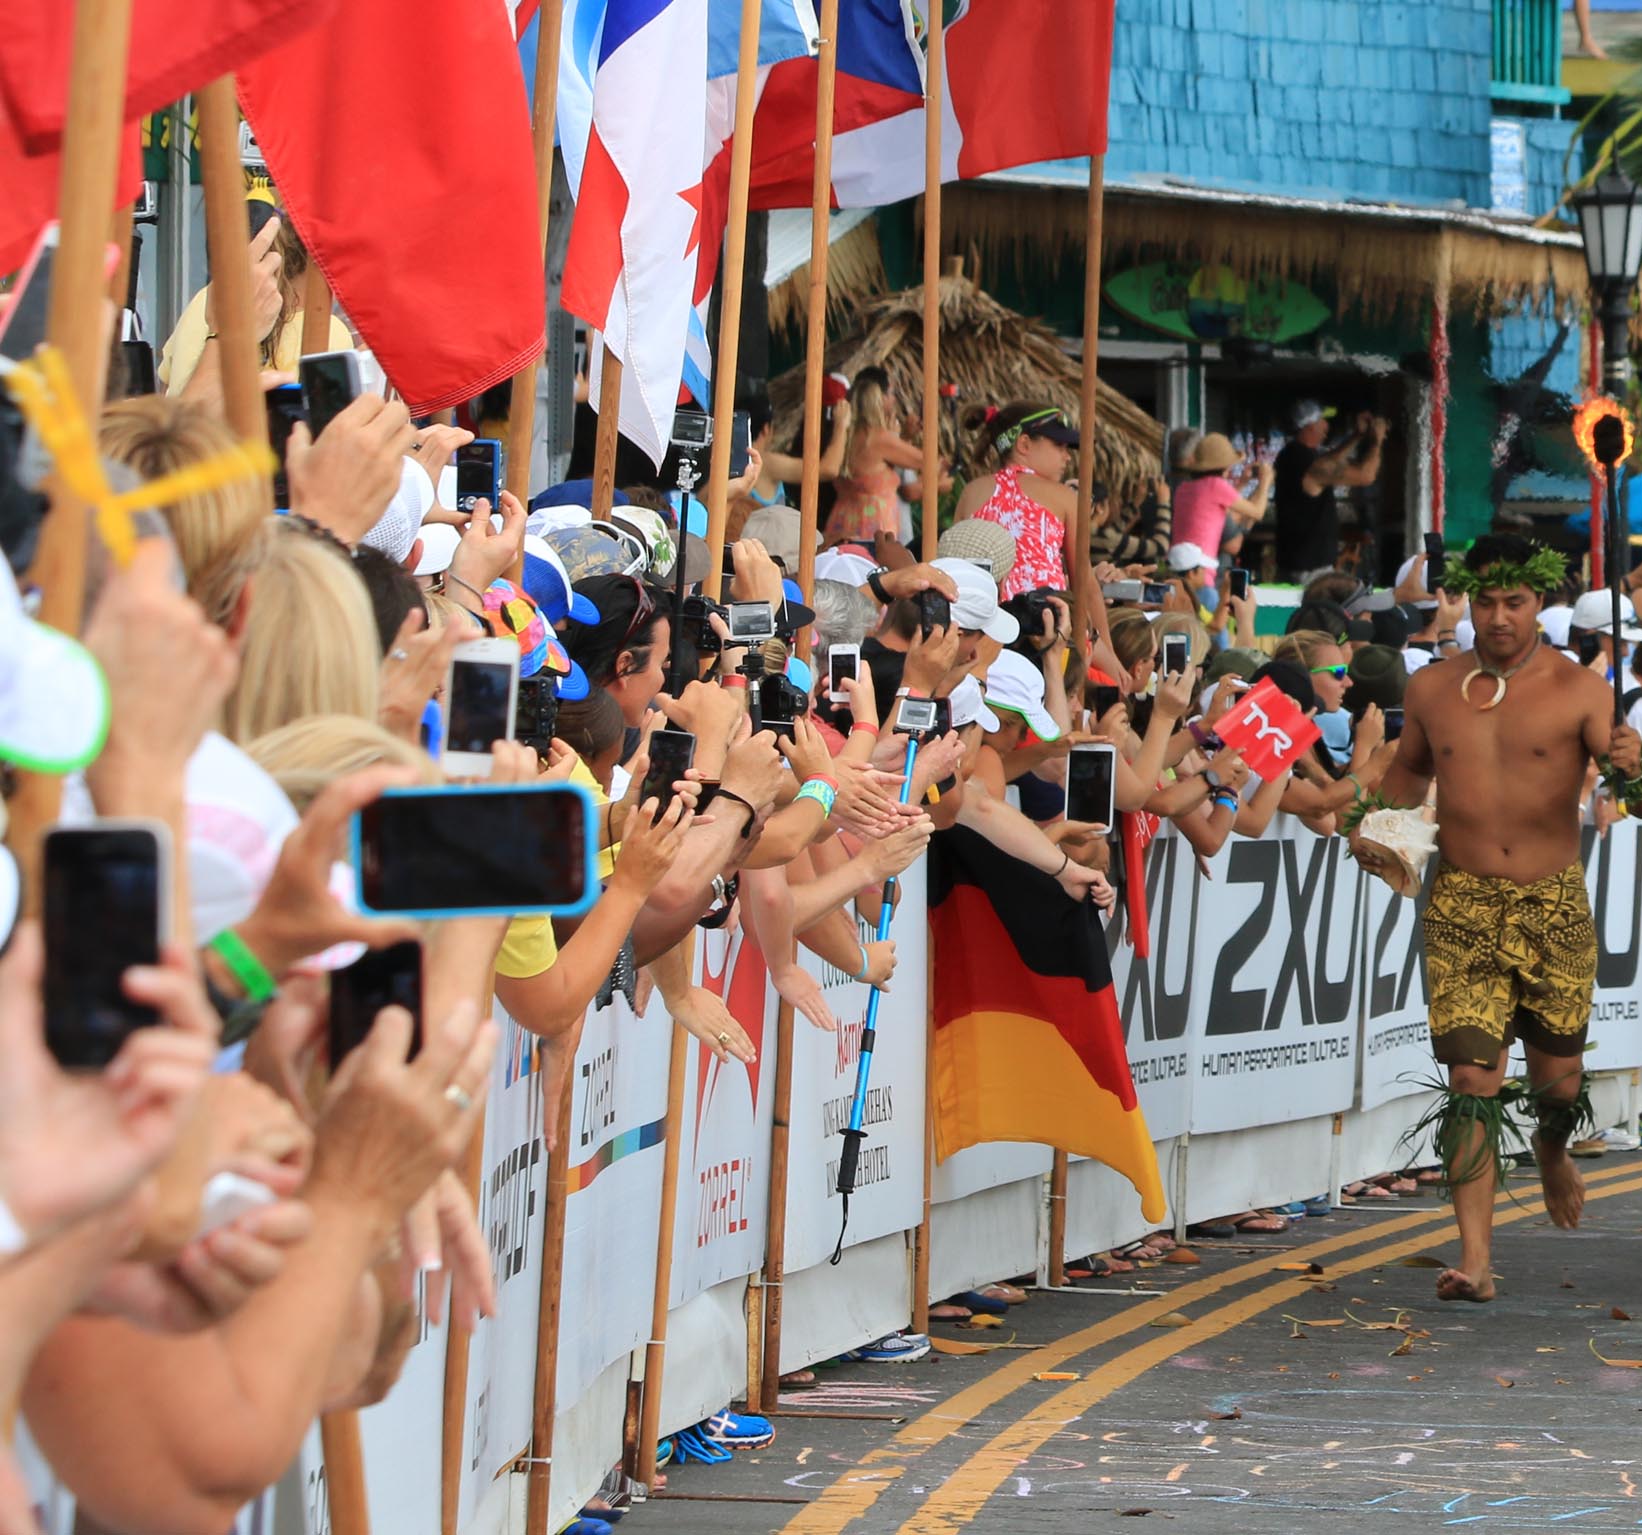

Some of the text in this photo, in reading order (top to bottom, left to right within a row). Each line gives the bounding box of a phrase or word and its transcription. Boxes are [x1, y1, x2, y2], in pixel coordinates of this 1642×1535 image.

[1242, 701, 1294, 759] TYR
[1204, 835, 1363, 1036] 2XU
[834, 1008, 868, 1080] Marrio
[1201, 1036, 1350, 1077] HUMAN PERFORMANCE MULTIPLIED
[863, 1145, 891, 1186] HOTEL
